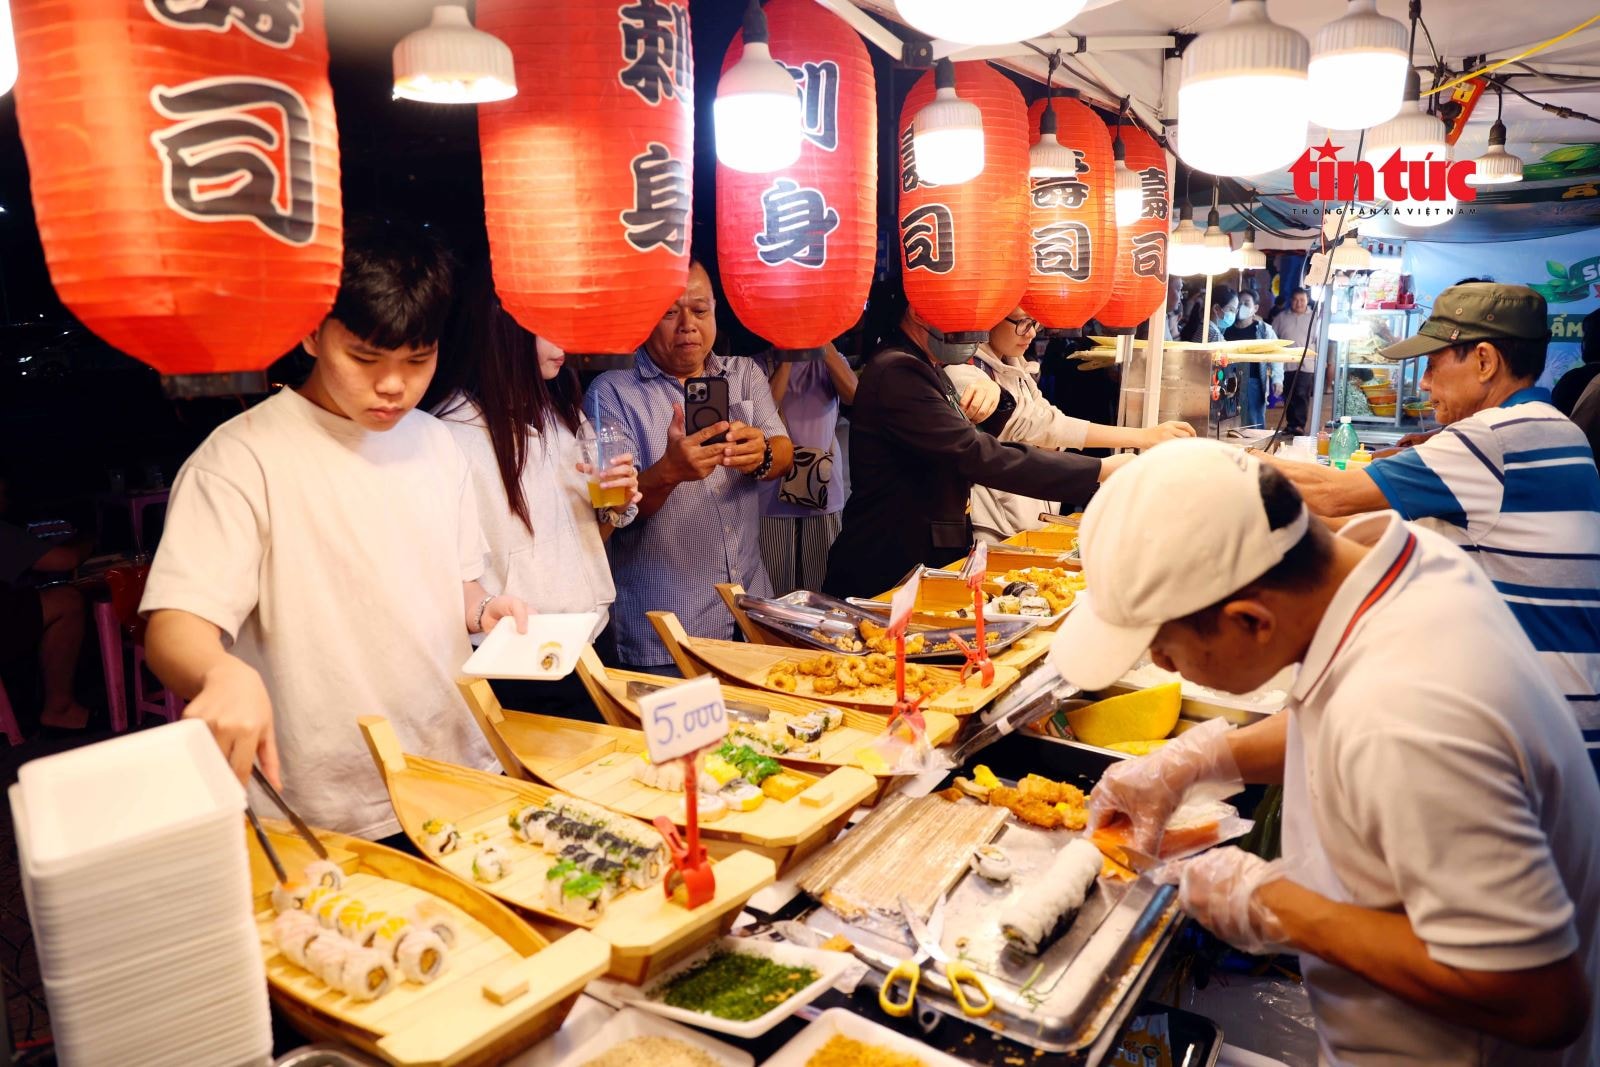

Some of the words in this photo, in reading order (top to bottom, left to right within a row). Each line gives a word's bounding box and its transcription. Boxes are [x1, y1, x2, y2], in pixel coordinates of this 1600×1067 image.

[144, 0, 317, 247] 司
[901, 121, 955, 274] 司
[1582, 263, 1600, 281] S
[653, 701, 725, 746] 5.000
